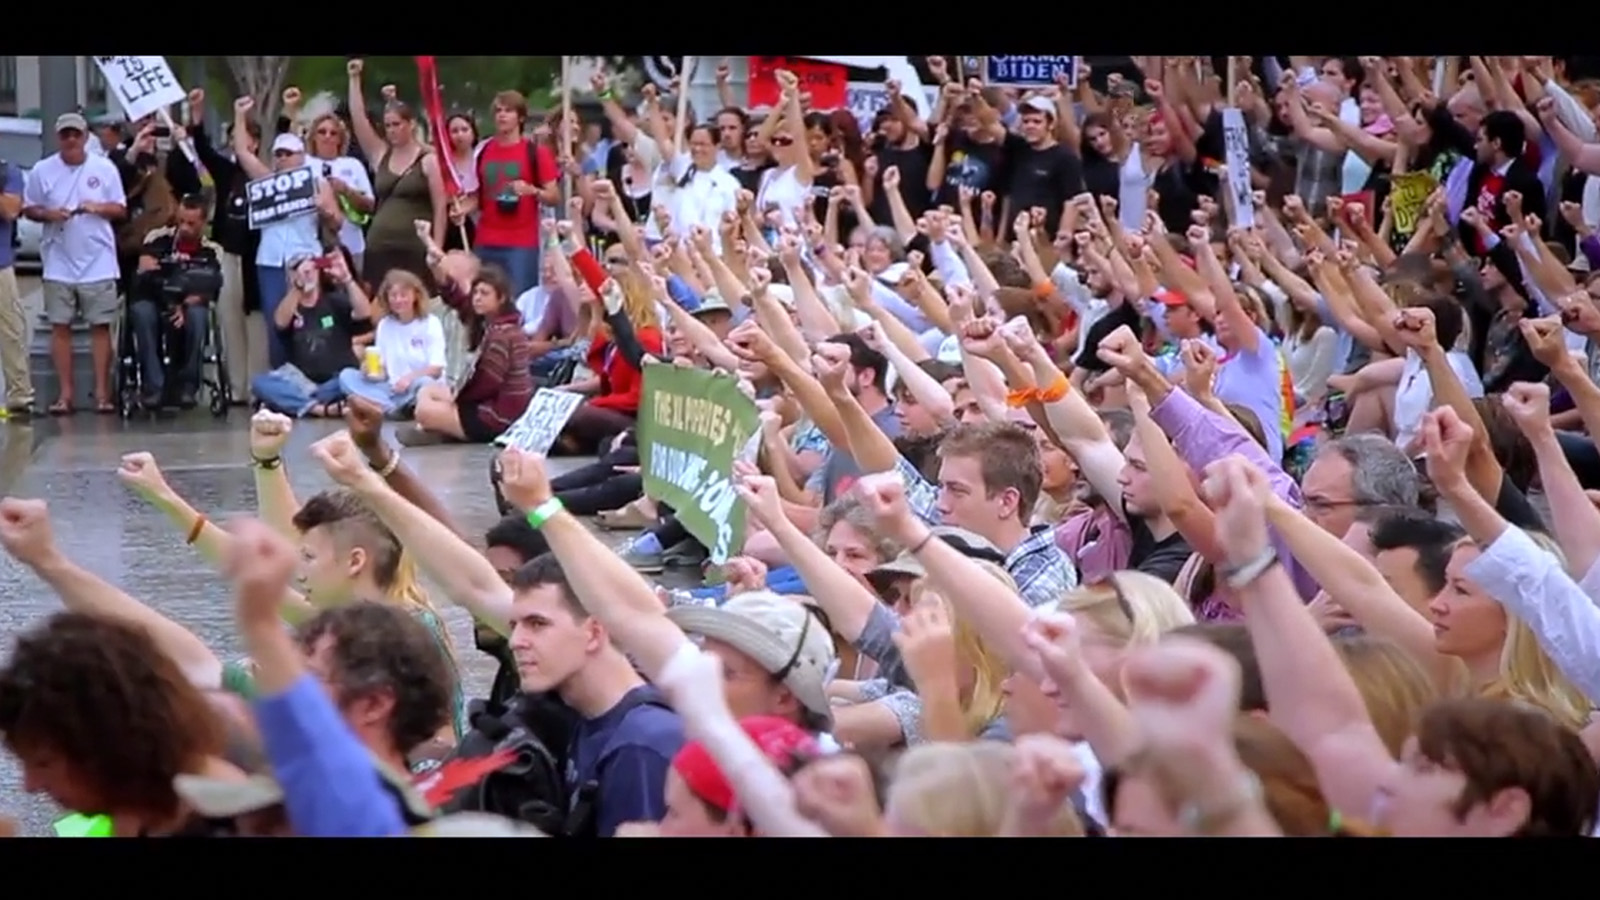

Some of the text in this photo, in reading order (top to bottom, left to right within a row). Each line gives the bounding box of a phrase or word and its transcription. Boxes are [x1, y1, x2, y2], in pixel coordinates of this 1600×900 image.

[120, 66, 171, 103] LIFE
[997, 63, 1066, 79] BIDEN
[251, 169, 310, 201] STOP
